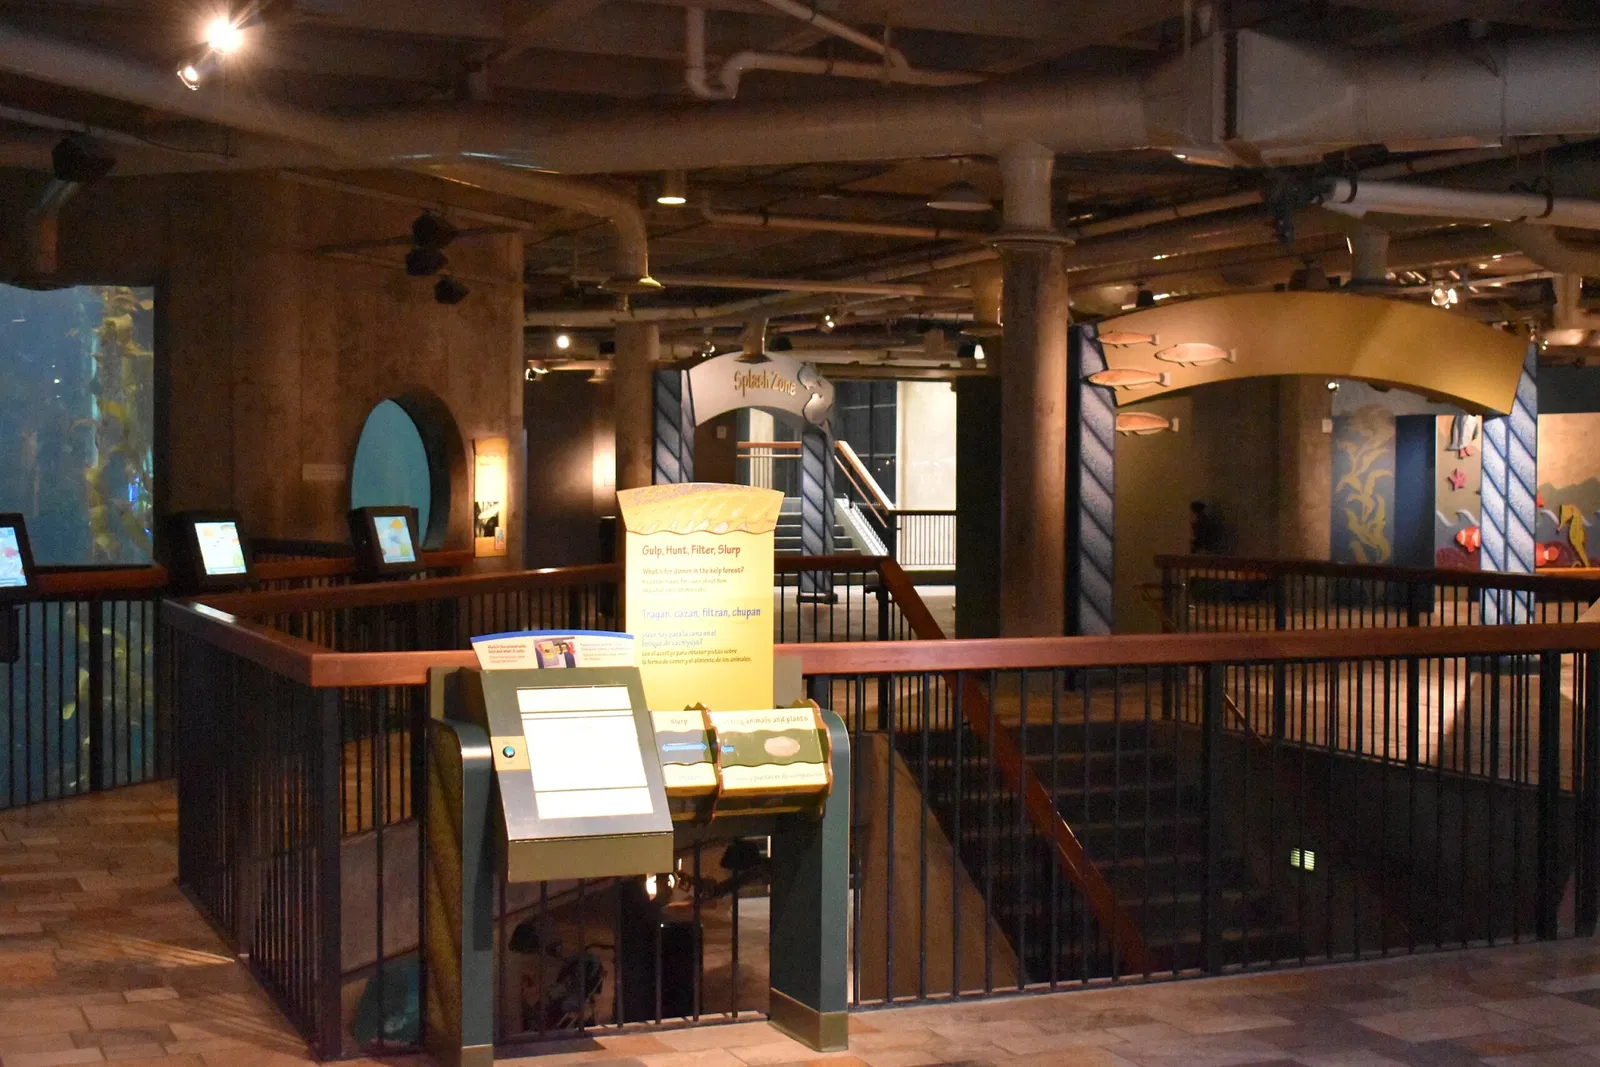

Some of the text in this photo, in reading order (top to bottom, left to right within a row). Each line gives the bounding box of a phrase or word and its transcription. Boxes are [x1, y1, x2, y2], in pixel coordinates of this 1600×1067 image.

[734, 369, 796, 397] Splash Zone
[642, 544, 741, 558] Gulp, Hunt, Filter, Slurp
[710, 567, 722, 576] kelp
[722, 566, 744, 574] forest?
[674, 609, 700, 618] cazan,
[702, 607, 730, 619] filtran,
[732, 606, 761, 620] chupan
[711, 629, 717, 637] el
[772, 715, 785, 723] and
[786, 715, 809, 724] plants
